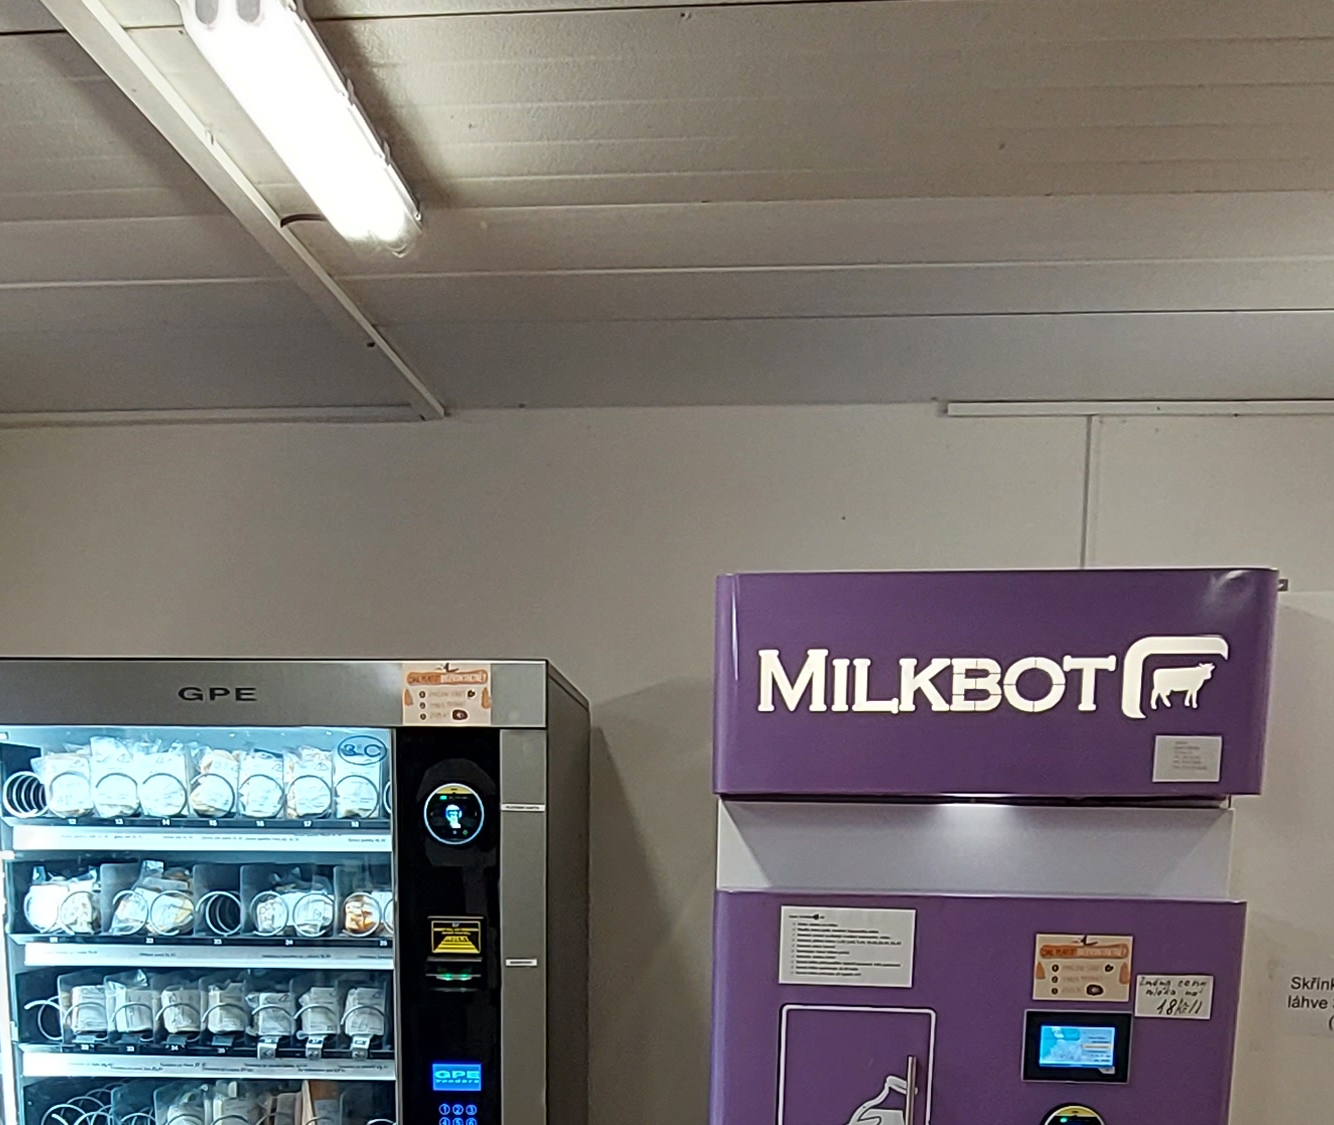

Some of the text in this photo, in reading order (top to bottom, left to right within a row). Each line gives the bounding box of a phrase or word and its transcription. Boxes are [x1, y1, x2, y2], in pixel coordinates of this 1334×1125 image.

[177, 686, 257, 702] GPE
[1287, 994, 1329, 1010] láhve
[434, 1070, 480, 1079] GPE
